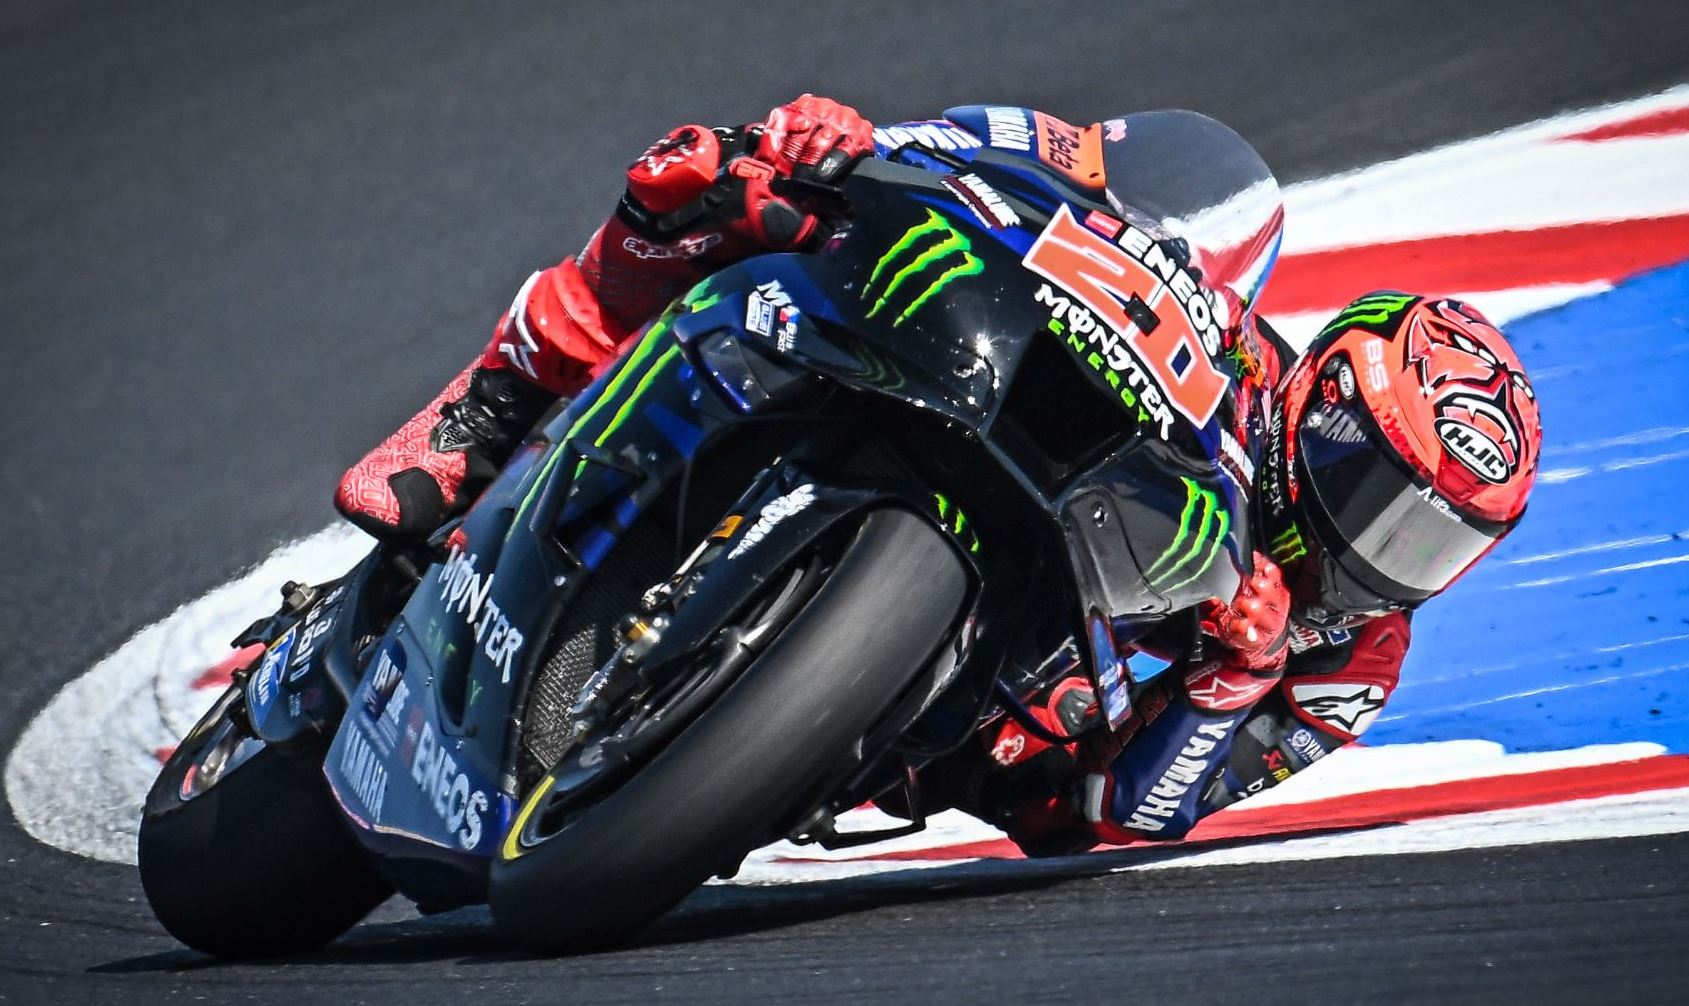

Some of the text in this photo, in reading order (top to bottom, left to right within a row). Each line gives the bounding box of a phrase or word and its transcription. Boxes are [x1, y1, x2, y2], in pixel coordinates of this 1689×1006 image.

[1118, 226, 1222, 357] ENEOS
[1034, 284, 1176, 441] MONSTER
[1047, 318, 1151, 424] ENERGY
[1367, 338, 1388, 392] BS
[1444, 427, 1505, 477] HJC
[438, 546, 524, 684] MONTER
[411, 720, 488, 850] ENEOS
[1124, 718, 1237, 833] YAMAHA
